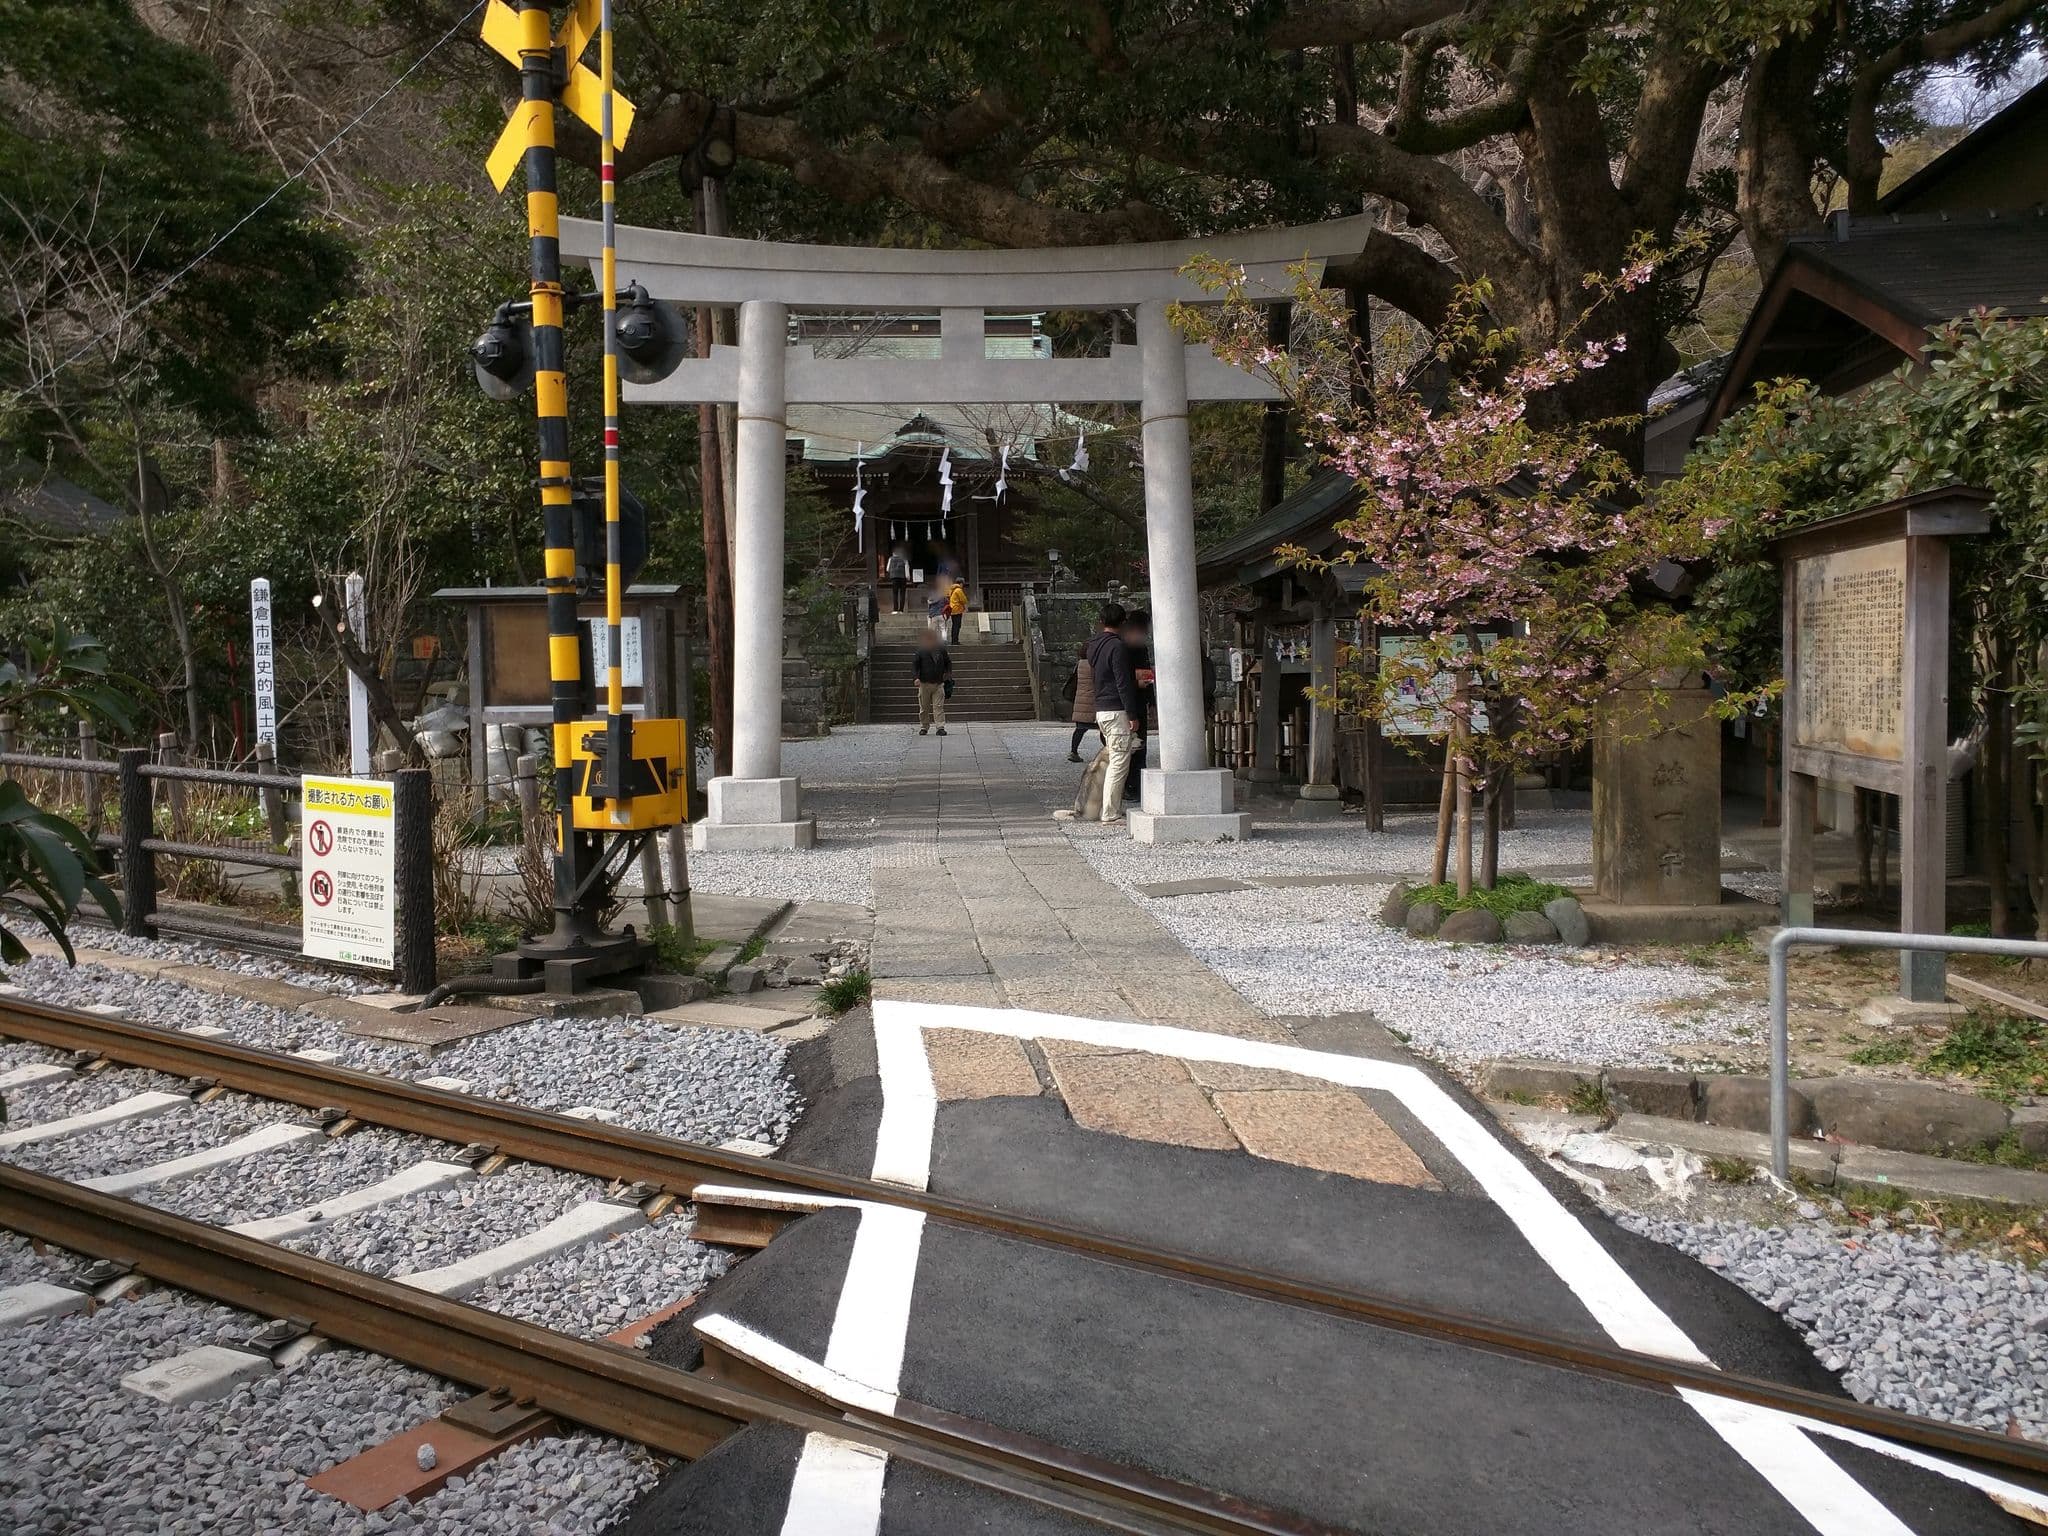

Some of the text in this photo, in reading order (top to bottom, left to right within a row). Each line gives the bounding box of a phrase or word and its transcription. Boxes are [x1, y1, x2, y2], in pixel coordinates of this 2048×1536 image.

[308, 789, 389, 809] 撮影される方へお願い
[338, 907, 354, 915] します。
